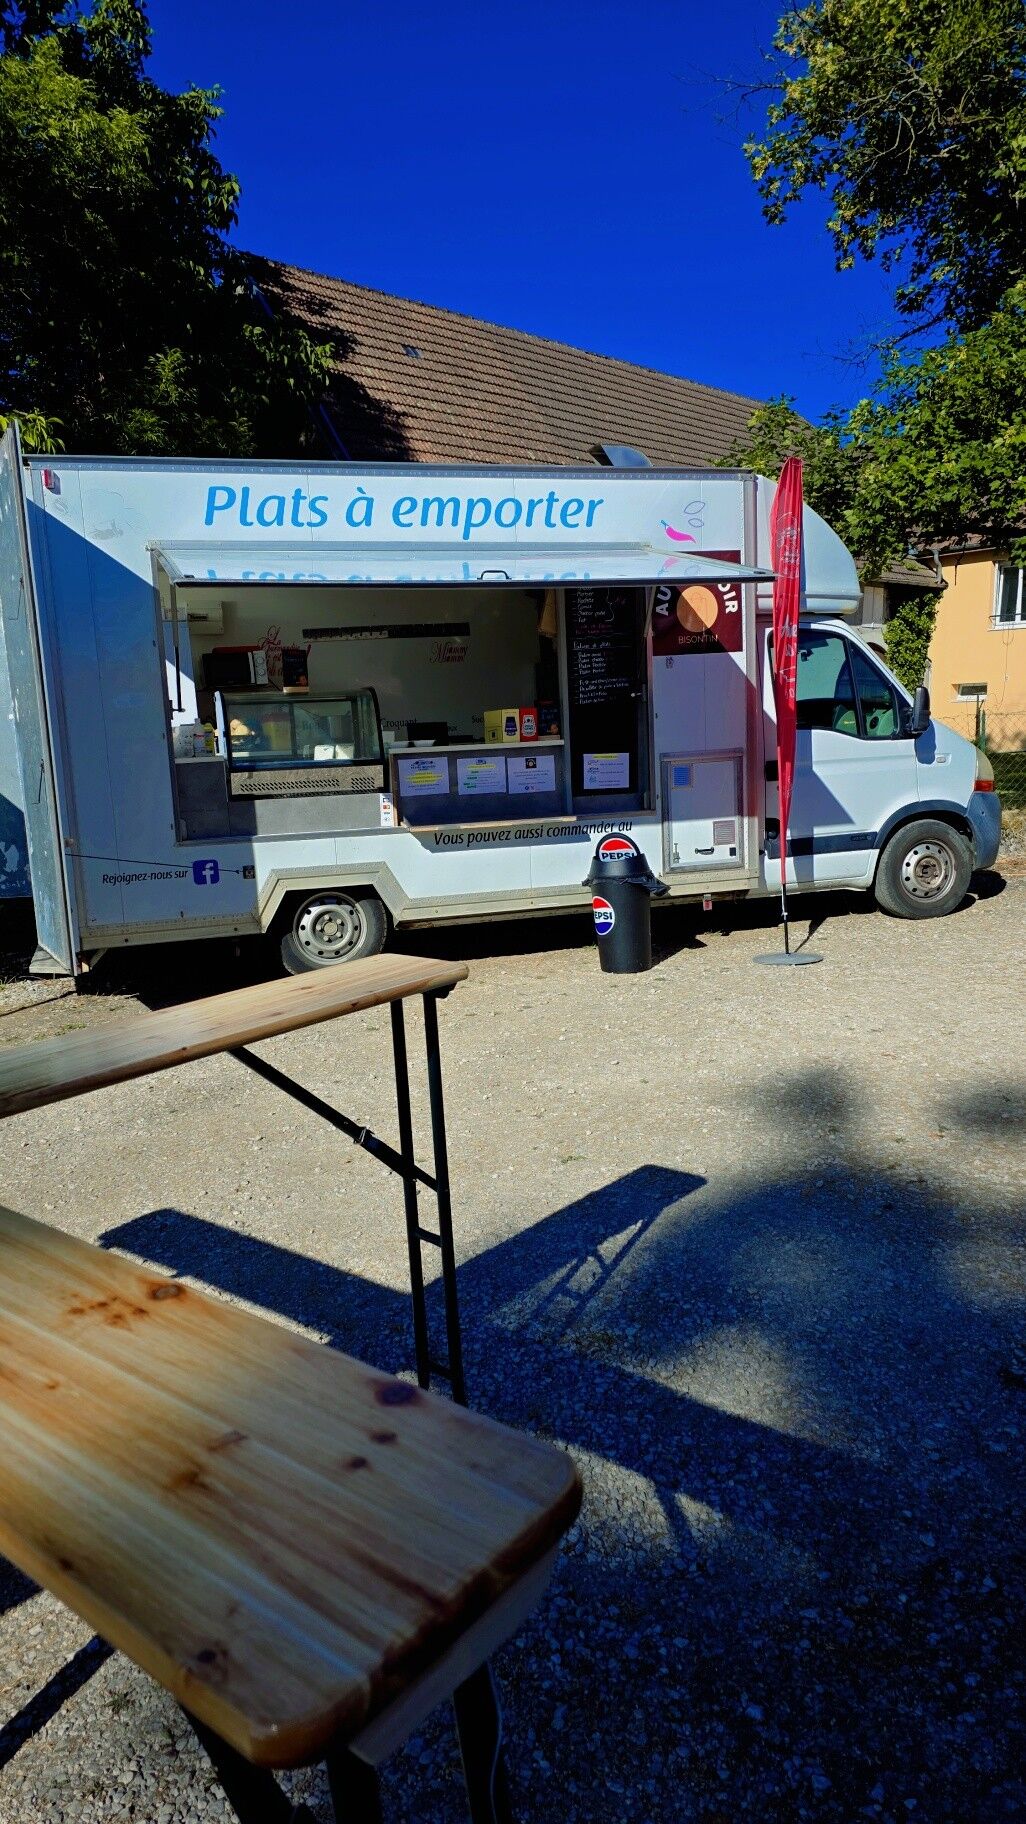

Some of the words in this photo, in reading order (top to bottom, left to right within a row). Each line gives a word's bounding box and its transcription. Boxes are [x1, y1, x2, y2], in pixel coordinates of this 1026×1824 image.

[204, 485, 329, 528] Plats
[345, 486, 375, 528] à
[391, 490, 604, 541] emporter
[677, 634, 719, 645] BISONTIN
[434, 831, 464, 846] Vous
[467, 830, 511, 847] pouvez
[514, 825, 544, 840] aussi
[547, 821, 615, 838] commander
[618, 821, 633, 832] au
[601, 852, 636, 861] PEPSI
[102, 869, 173, 886] Rejoignez-nous
[174, 869, 188, 879] sur
[594, 911, 613, 920] EPSI
